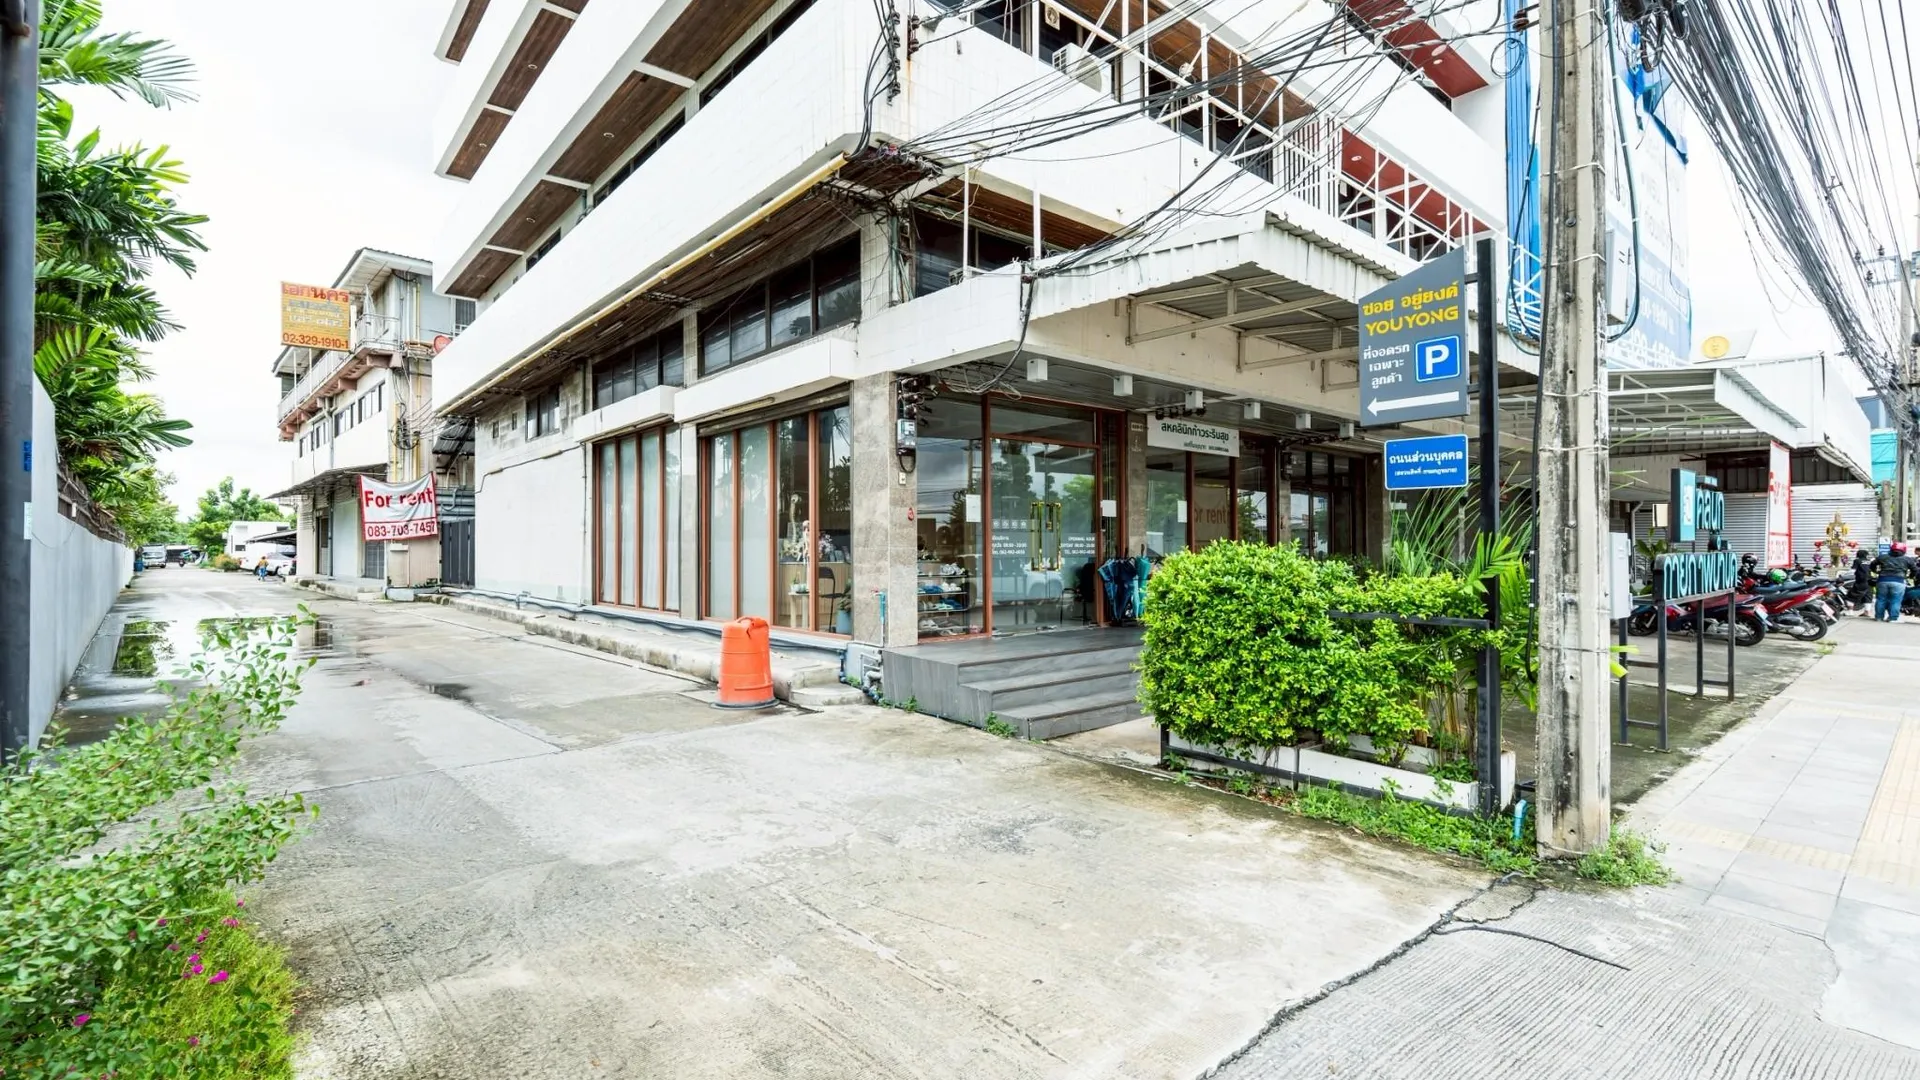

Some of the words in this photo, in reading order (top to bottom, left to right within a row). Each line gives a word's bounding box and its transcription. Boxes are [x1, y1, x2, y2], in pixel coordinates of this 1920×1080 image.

[1362, 299, 1394, 316] ซอย
[1365, 306, 1459, 336] YOUYONG
[1363, 343, 1410, 360] ที่จอดรถ
[1425, 344, 1450, 375] P
[1369, 358, 1405, 372] เฉพาะ
[1371, 372, 1403, 389] ลูกค้า
[1389, 450, 1464, 466] ถนนส่วนบุคคล
[364, 490, 393, 508] For
[399, 487, 433, 506] rent
